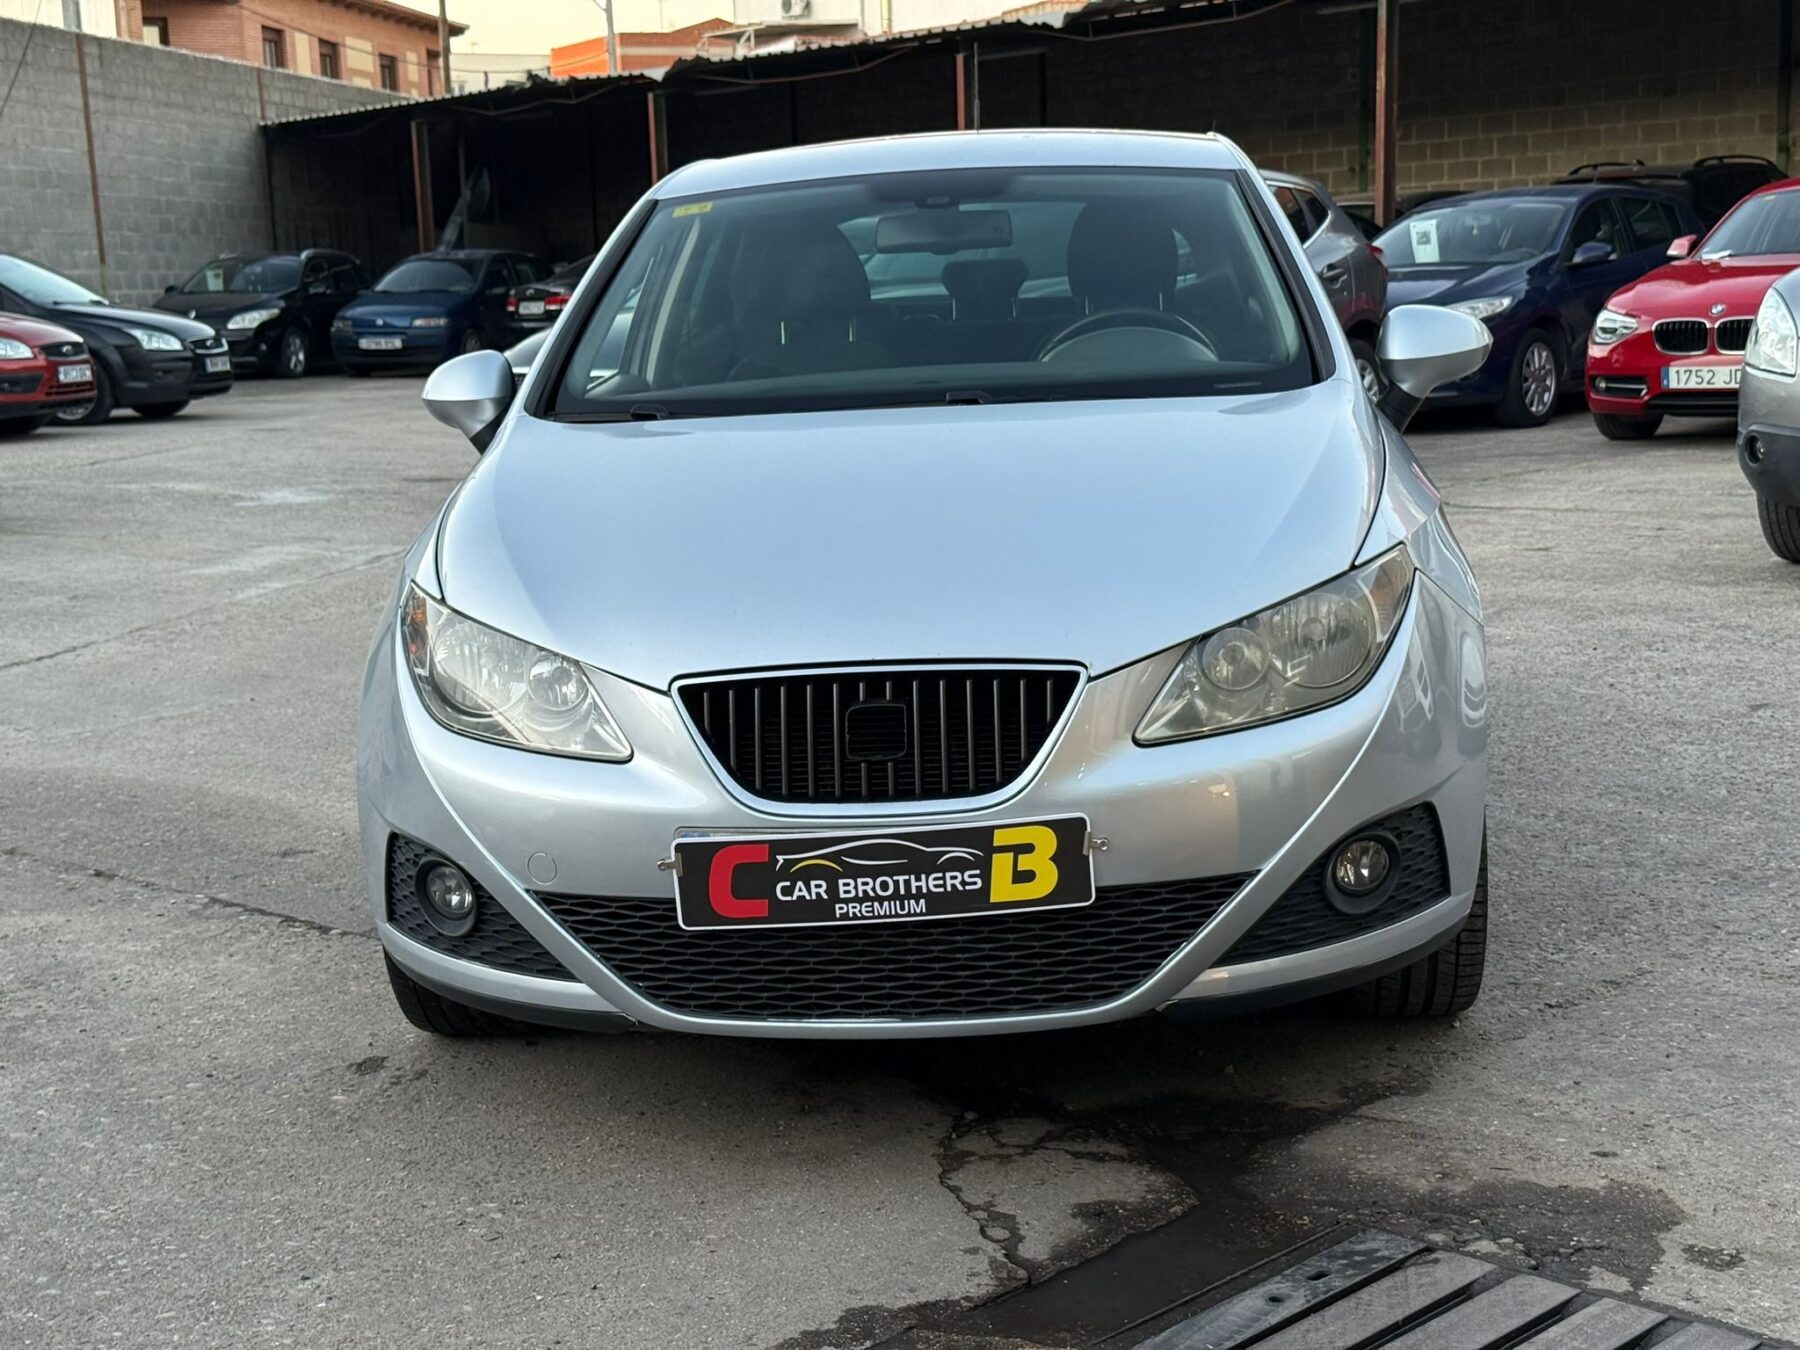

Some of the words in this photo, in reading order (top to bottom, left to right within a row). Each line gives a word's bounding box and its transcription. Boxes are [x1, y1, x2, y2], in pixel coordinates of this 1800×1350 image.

[1675, 368, 1716, 386] 1752
[990, 825, 1059, 903] B
[709, 843, 769, 918] C
[775, 880, 829, 901] CAR
[838, 869, 983, 899] BROTHERS
[835, 898, 927, 918] PREMIUM
